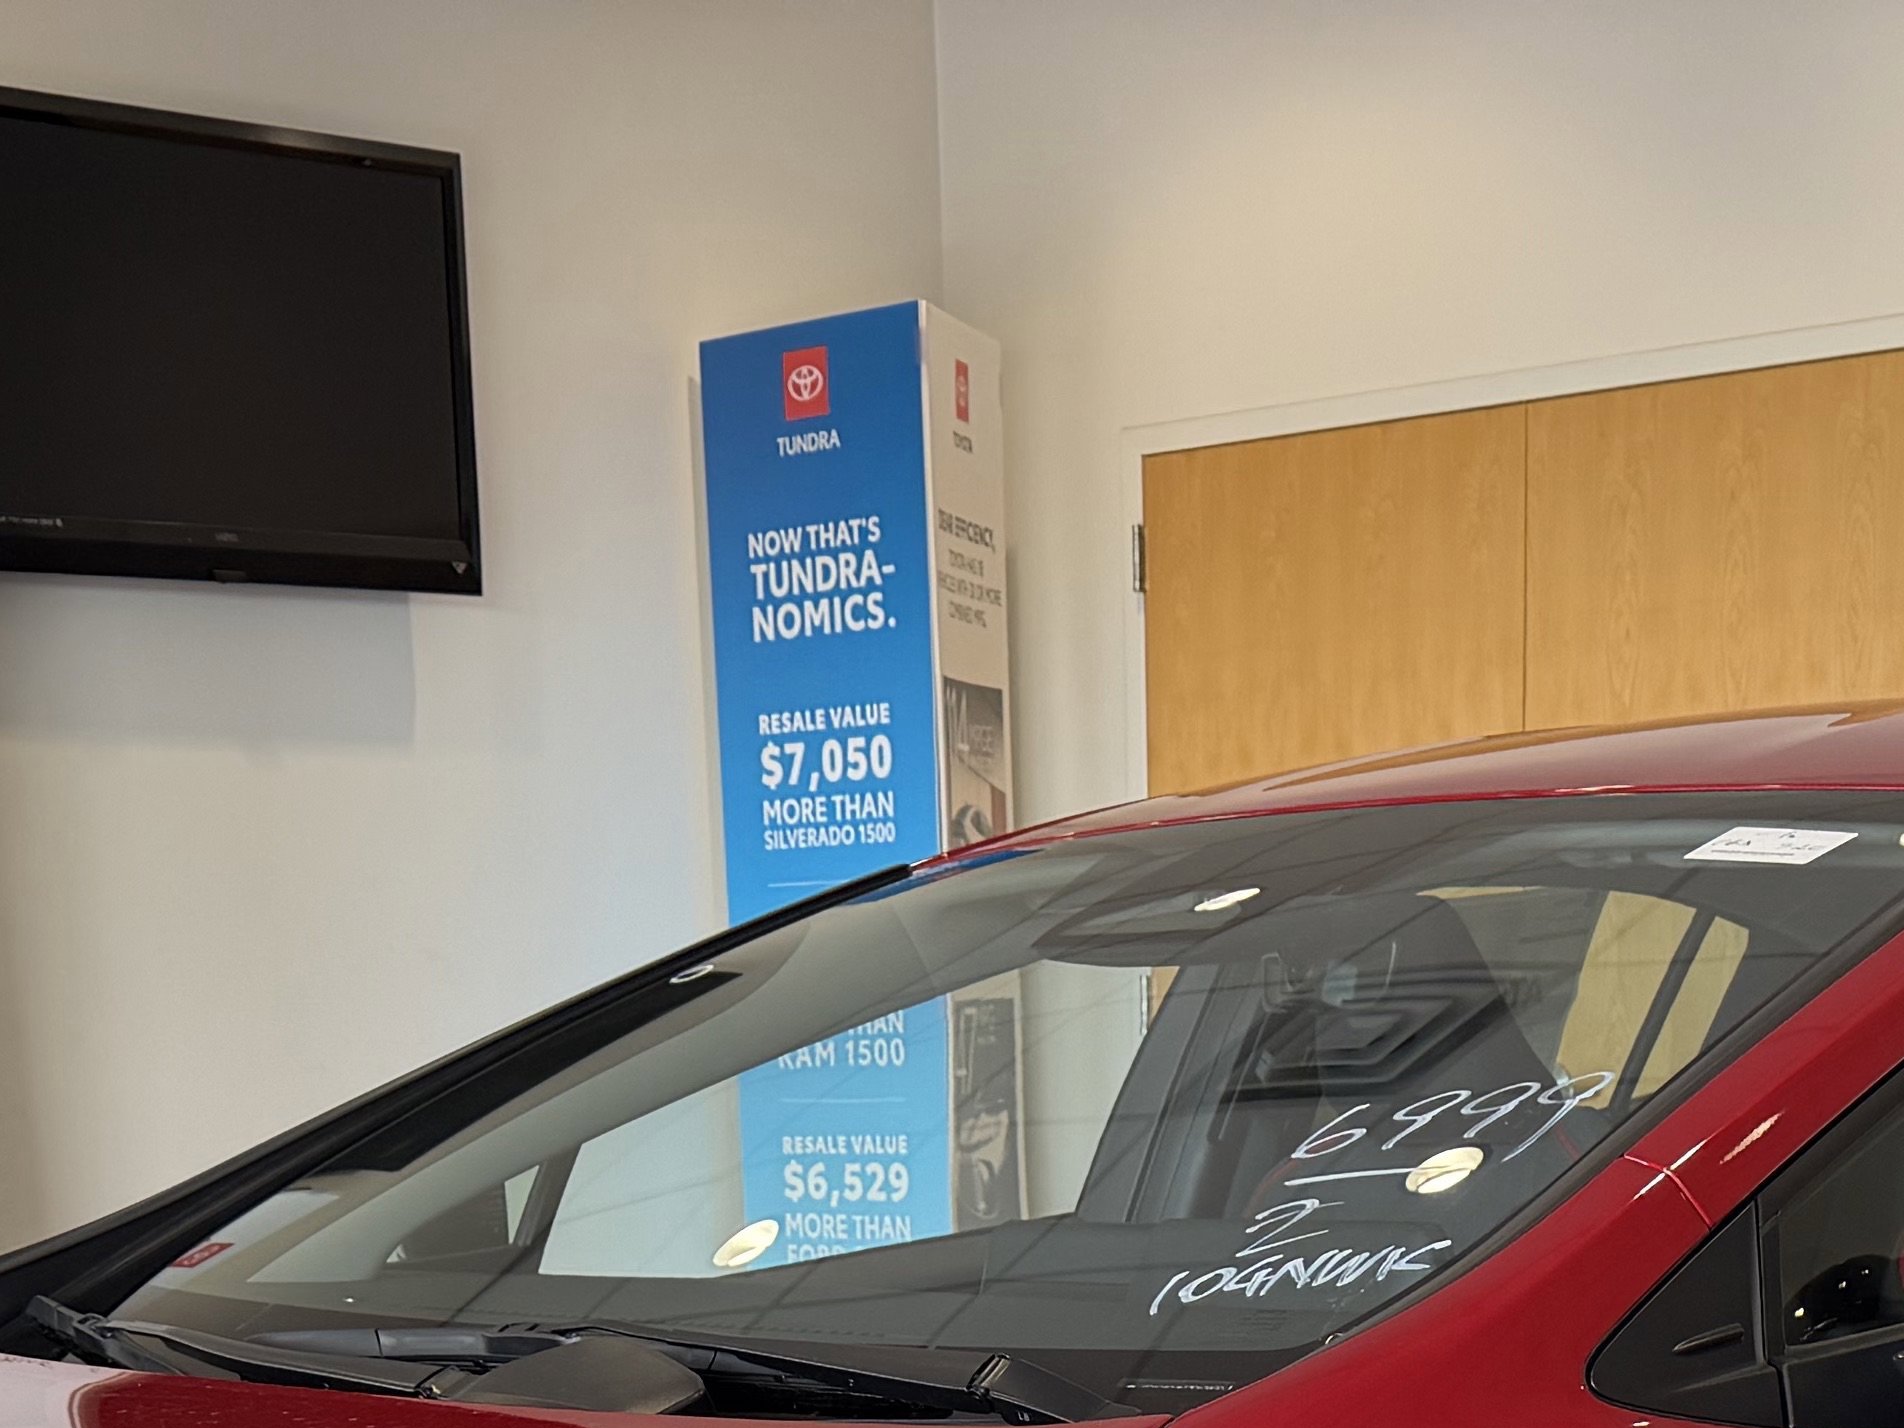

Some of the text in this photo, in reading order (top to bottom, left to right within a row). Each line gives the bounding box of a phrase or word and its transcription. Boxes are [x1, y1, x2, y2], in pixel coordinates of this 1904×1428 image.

[776, 428, 842, 458] TUNDRA
[747, 514, 882, 560] NOW THAT'S
[750, 548, 897, 600] TUNDRA-
[751, 593, 897, 643] NOMICS.
[758, 702, 891, 736] RESALE VALUE
[760, 735, 893, 792] $7,050
[762, 791, 895, 826] MORE THAN
[764, 822, 896, 851] SILVERADO 1500
[845, 1037, 906, 1068] 1500
[1290, 1070, 1616, 1162] 6999
[782, 1134, 909, 1155] RESALE VALUE
[783, 1158, 910, 1208] $6,529
[785, 1213, 913, 1242] MORE THAN
